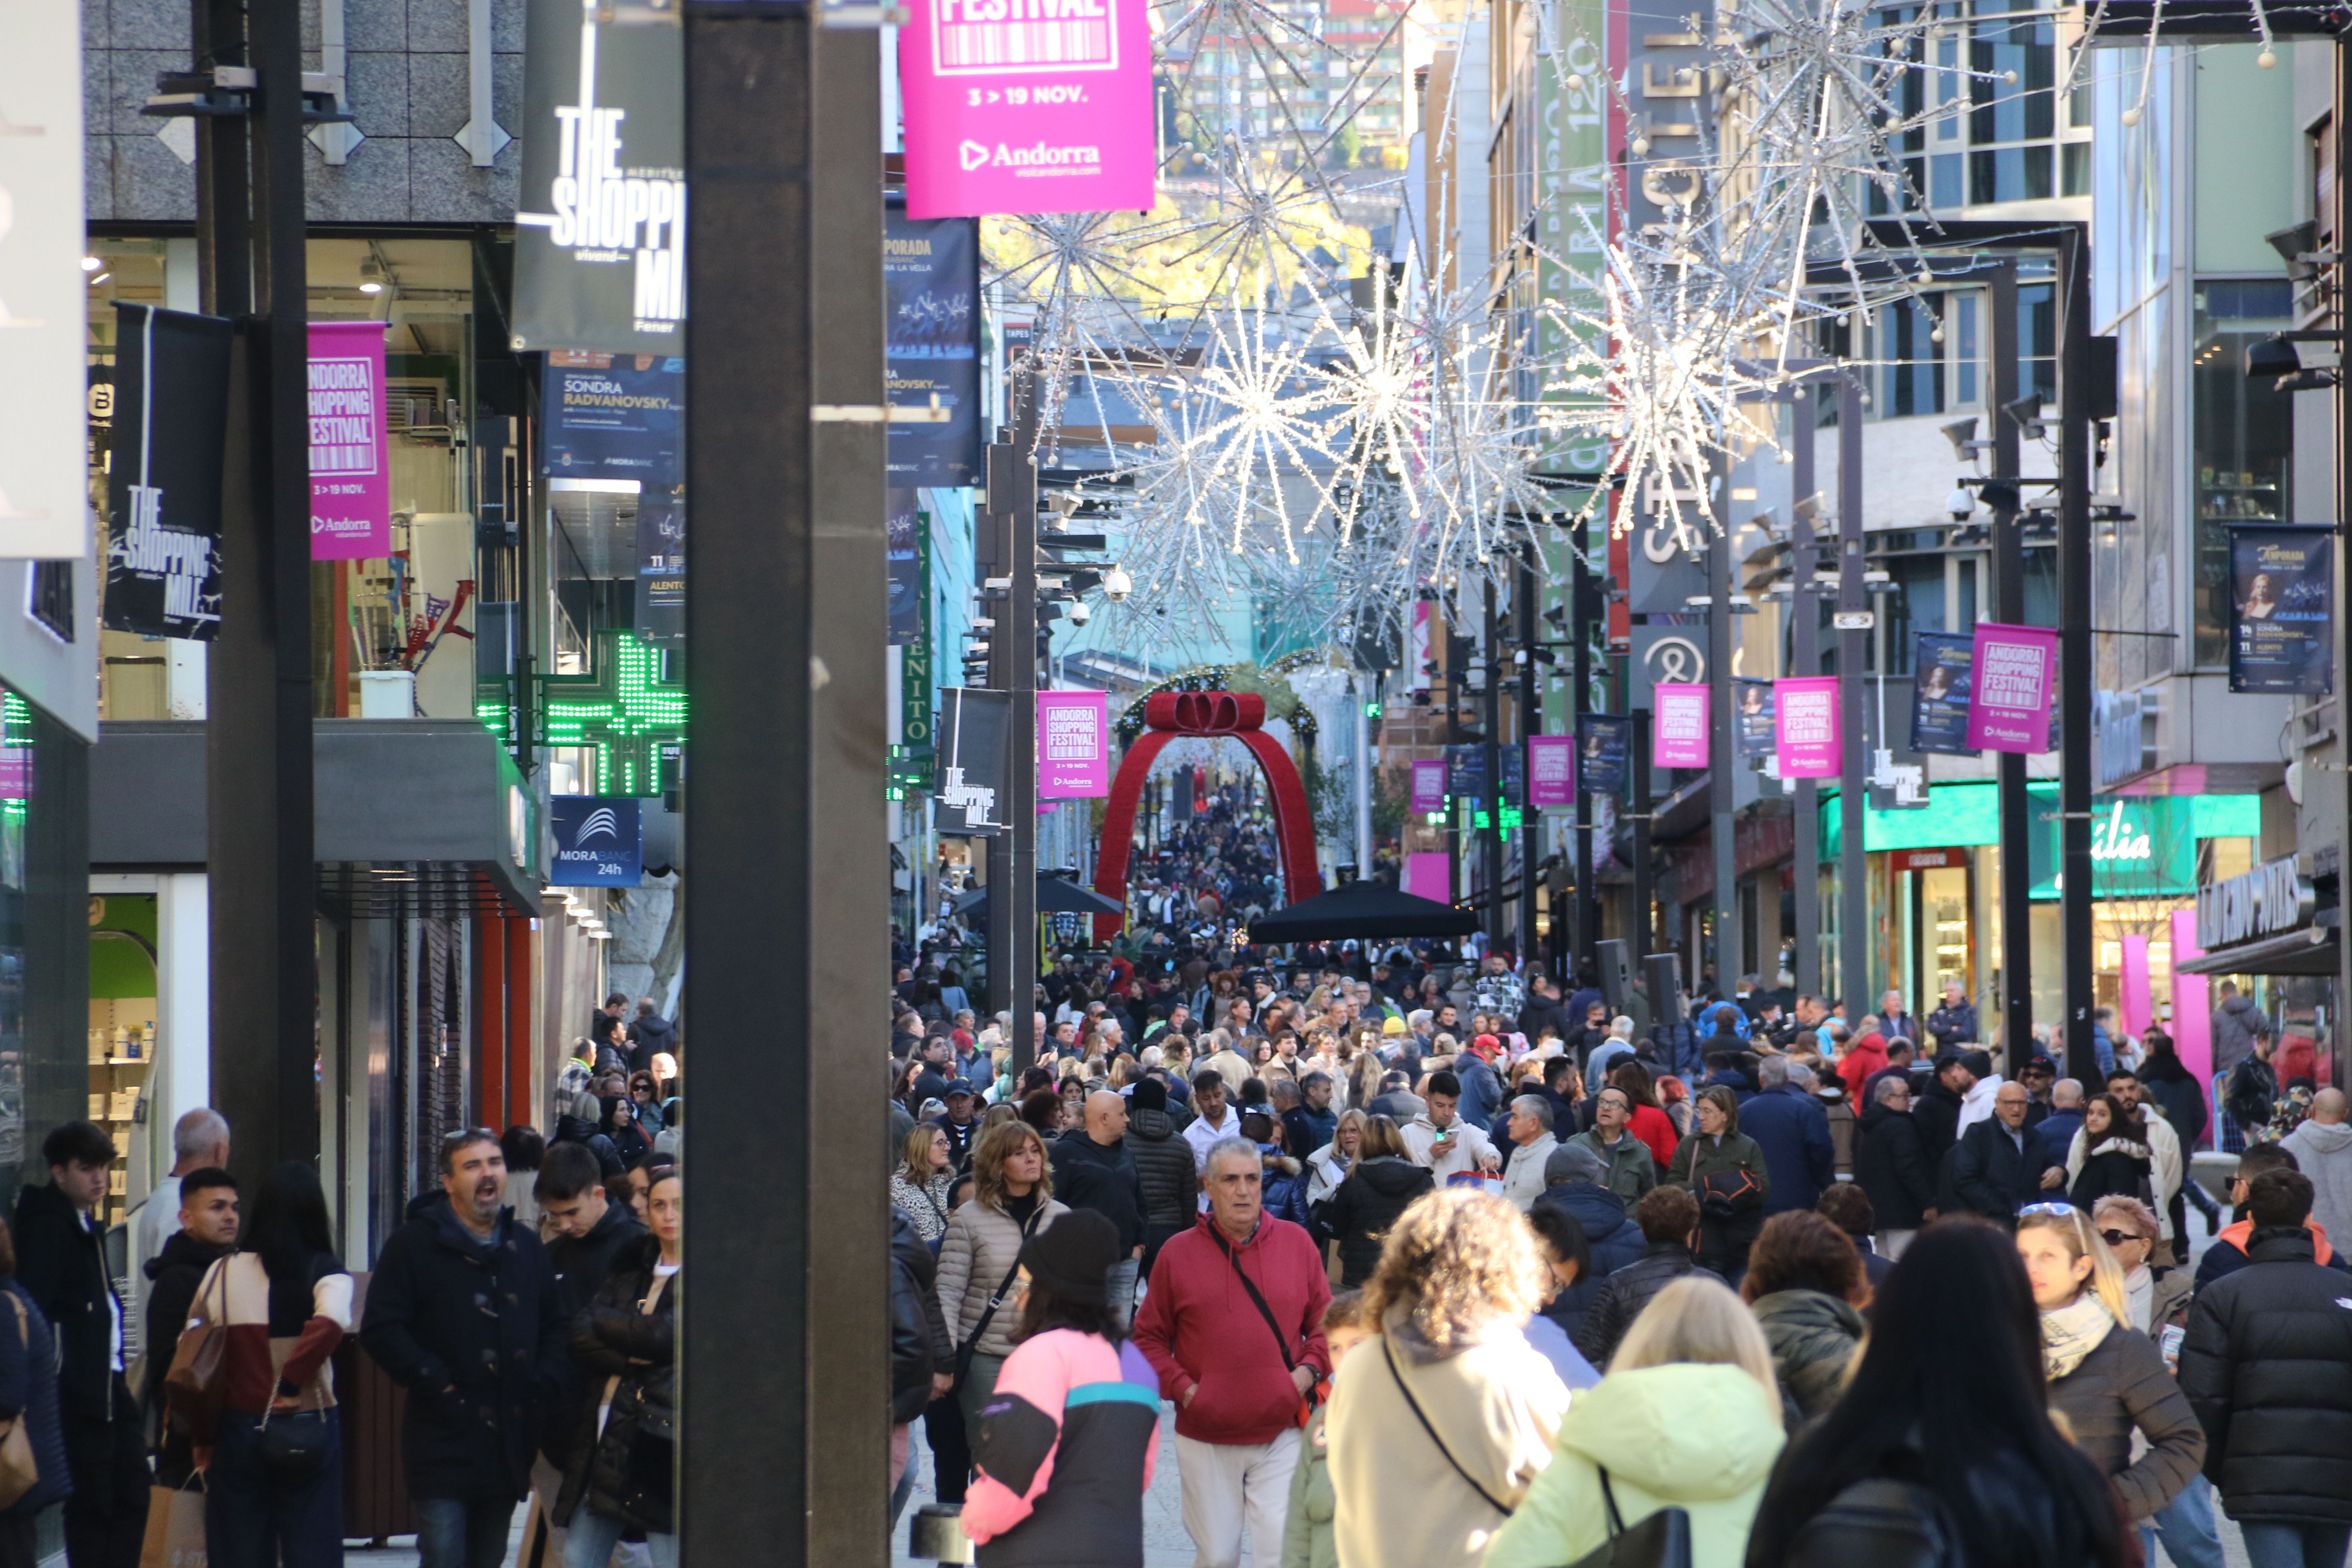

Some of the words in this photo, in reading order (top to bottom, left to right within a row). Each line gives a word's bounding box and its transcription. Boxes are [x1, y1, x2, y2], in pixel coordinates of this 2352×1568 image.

[968, 89, 981, 106] 3
[1005, 87, 1029, 104] 19
[1033, 85, 1089, 104] NOV.
[555, 106, 625, 178] THE
[992, 141, 1100, 166] Andorra
[1015, 165, 1101, 178] visitandorra.com
[550, 178, 686, 249] SHOPPI
[883, 239, 932, 255] PORADA
[634, 320, 675, 333] Fener
[1006, 330, 1029, 338] TAPES
[308, 364, 369, 390] NDORRA
[564, 380, 623, 394] SONDRA
[308, 391, 371, 416] HOPPING
[564, 393, 670, 409] RADVANOVSKY
[310, 416, 372, 444] ESTIVAL
[314, 485, 321, 495] 3
[330, 485, 340, 494] 19
[342, 484, 366, 494] NOV.
[128, 486, 163, 530] THE
[325, 518, 371, 531] Andorra
[123, 527, 211, 578] SHOPPING
[164, 573, 221, 622] MILE
[1988, 646, 2041, 664] ANDORRA
[1986, 660, 2040, 678] SHOPPING
[906, 619, 927, 739] ENITO
[1985, 674, 2038, 694] FESTIVAL
[1050, 709, 1094, 721] ANDORRA
[1050, 721, 1094, 733] SHOPPING
[1050, 733, 1095, 746] FESTIVAL
[946, 767, 965, 787] THE
[943, 786, 995, 807] SHOPPING
[965, 805, 1002, 826] MILE
[560, 850, 631, 861] MORABANC
[597, 863, 622, 875] 24h
